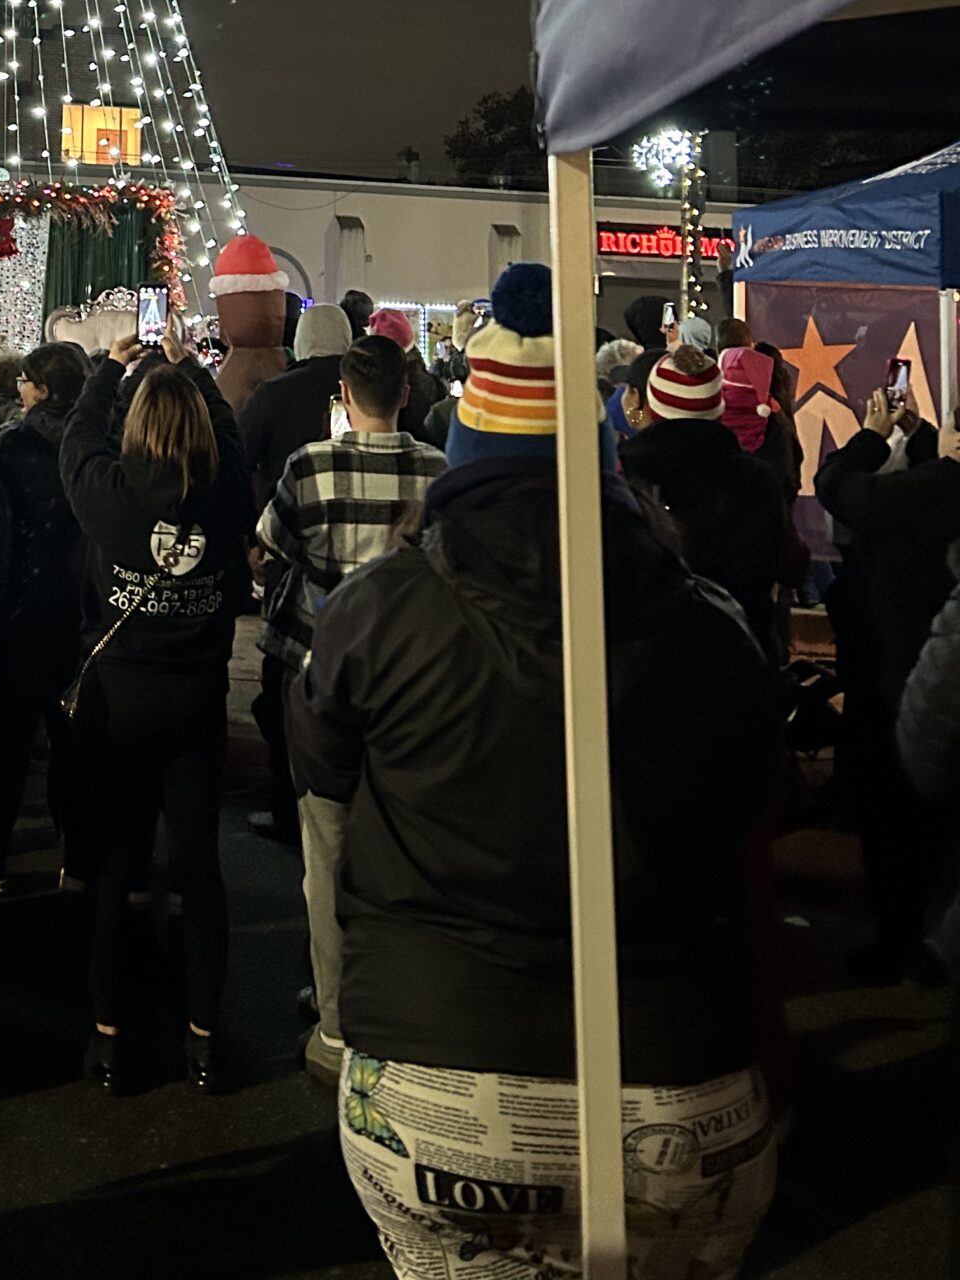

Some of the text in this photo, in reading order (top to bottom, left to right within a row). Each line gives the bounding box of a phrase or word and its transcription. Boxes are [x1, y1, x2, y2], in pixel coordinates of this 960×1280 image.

[820, 229, 880, 249] IMPROVEMENT
[881, 229, 931, 250] DISTRICT
[112, 564, 140, 583] 7360
[424, 1171, 556, 1213] LOVE
